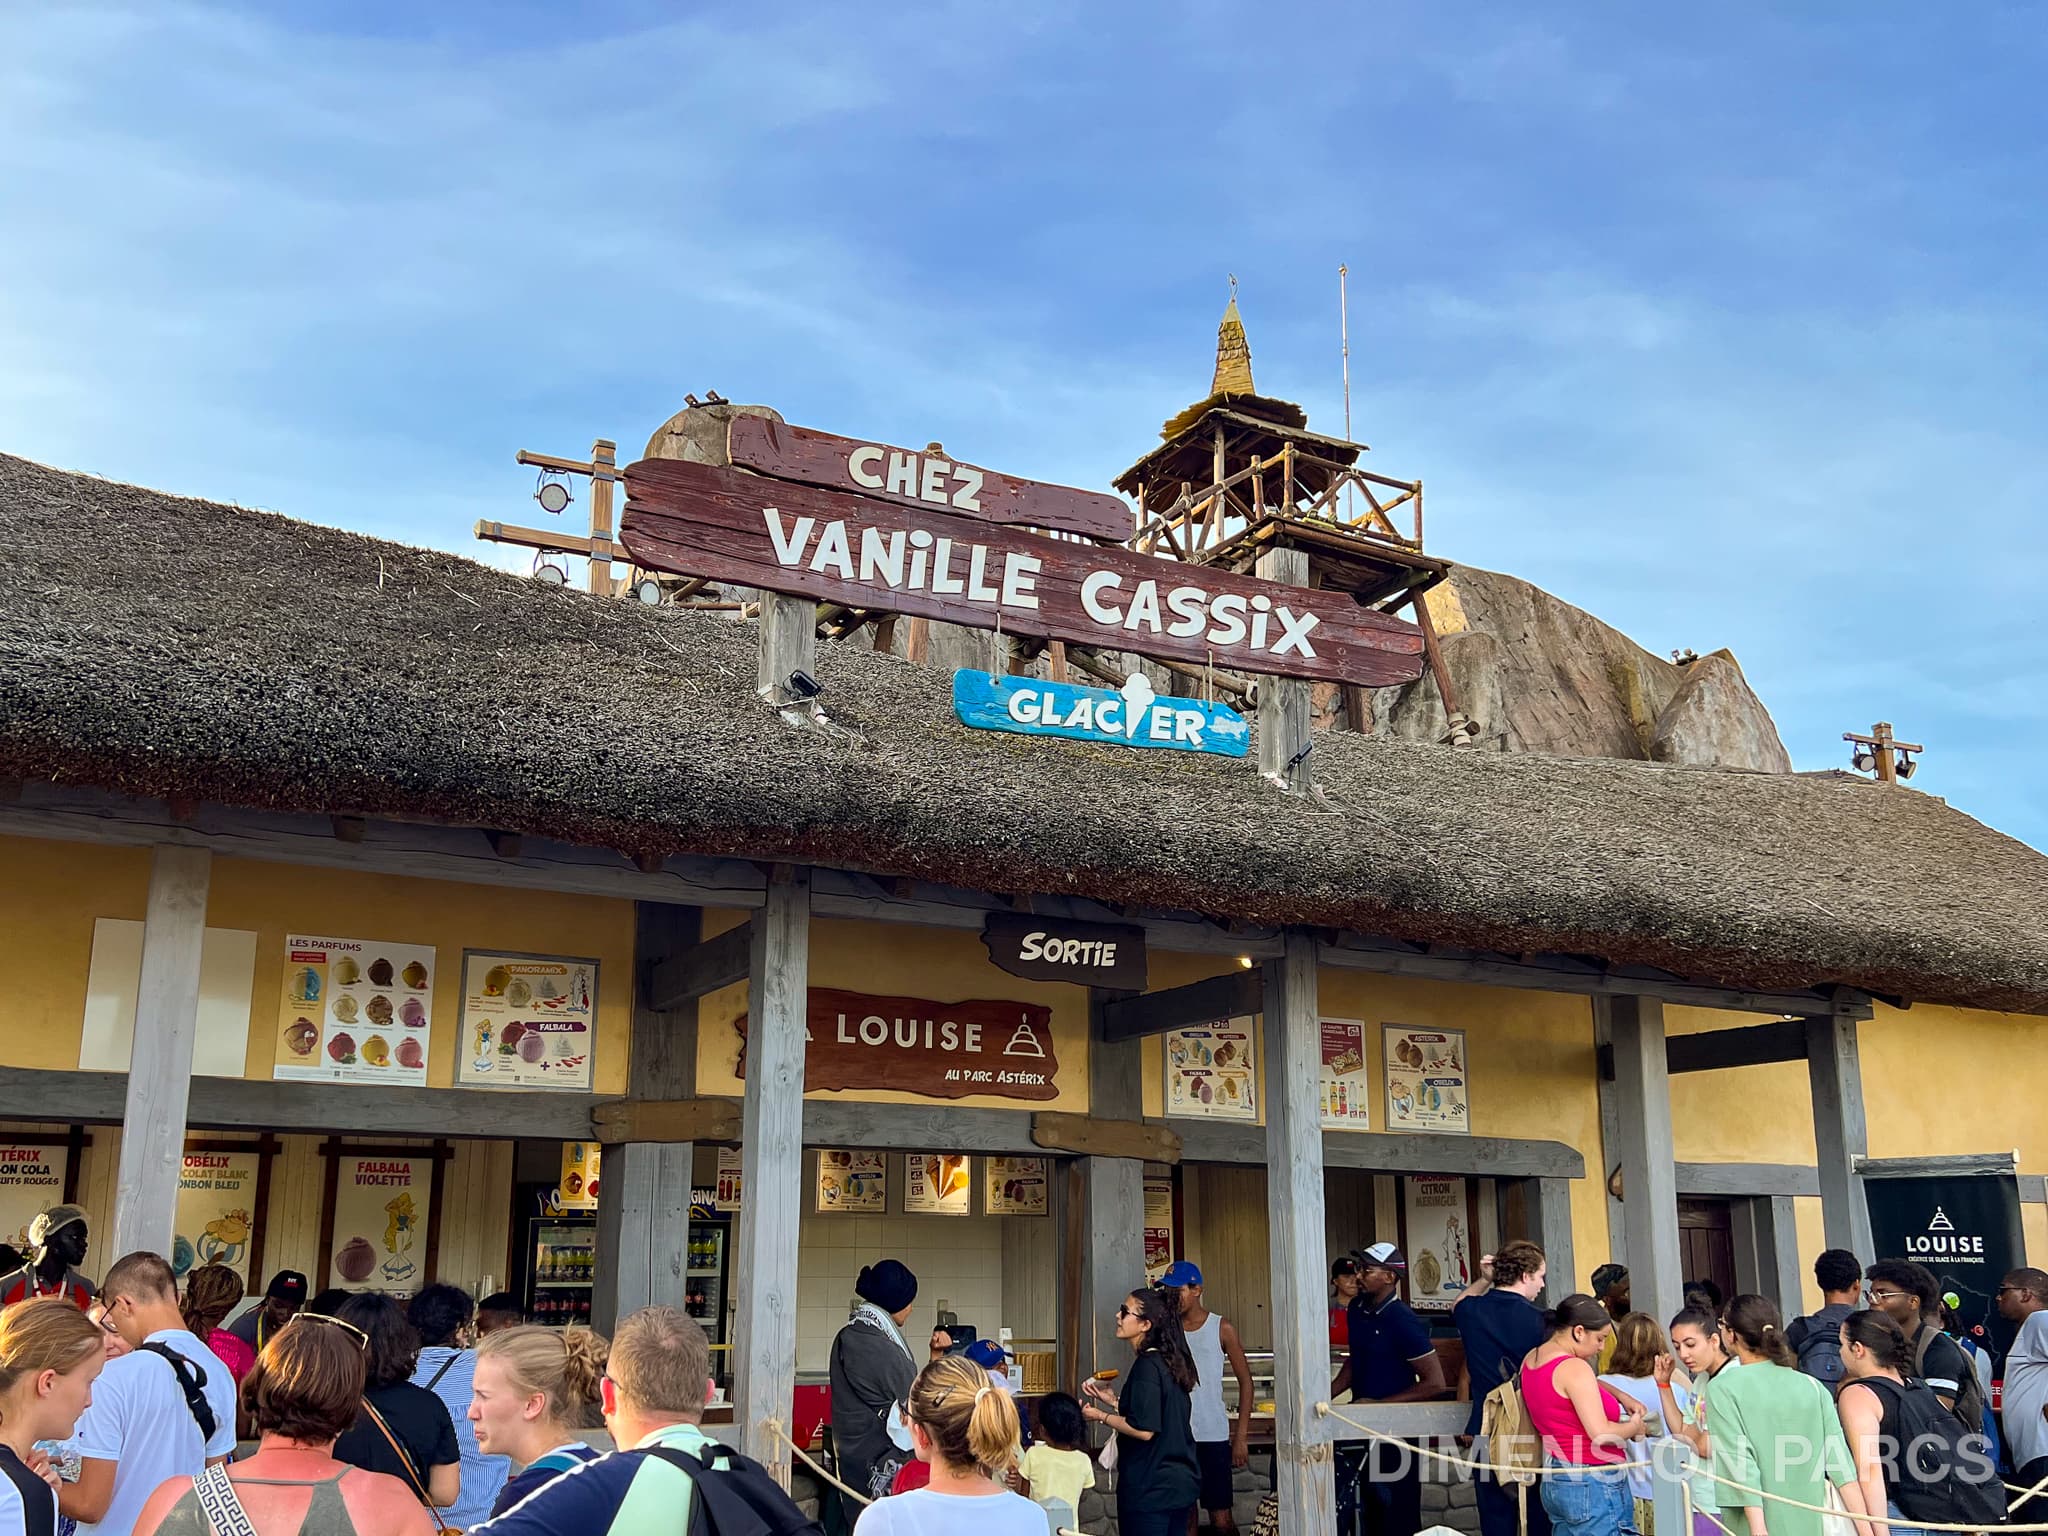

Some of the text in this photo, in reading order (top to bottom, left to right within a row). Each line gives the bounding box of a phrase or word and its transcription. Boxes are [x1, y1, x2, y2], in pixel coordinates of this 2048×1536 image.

[849, 445, 984, 512] CHEZ
[763, 506, 1320, 658] VANILLE CASSIX
[290, 938, 362, 952] LES PARFUMS
[1019, 931, 1117, 968] SORTIE
[511, 965, 563, 975] PANORAMIX
[539, 1022, 573, 1031] FALBALA
[837, 1013, 983, 1053] LOUISE
[944, 1069, 1045, 1085] AU PARC ASTÉRIX
[0, 1145, 41, 1162] TÉRIX
[184, 1152, 230, 1168] OBÉLIX
[0, 1164, 50, 1175] ON COLA
[182, 1169, 249, 1180] COLAT BLANC
[357, 1161, 411, 1174] FALBALA
[0, 1177, 59, 1186] UITS ROUGES
[179, 1179, 240, 1190] ONBON BLEU
[354, 1173, 412, 1187] VIOLETTE
[1420, 1183, 1450, 1194] CITRON
[691, 1189, 717, 1206] GINA
[1905, 1236, 1984, 1253] LOUISE
